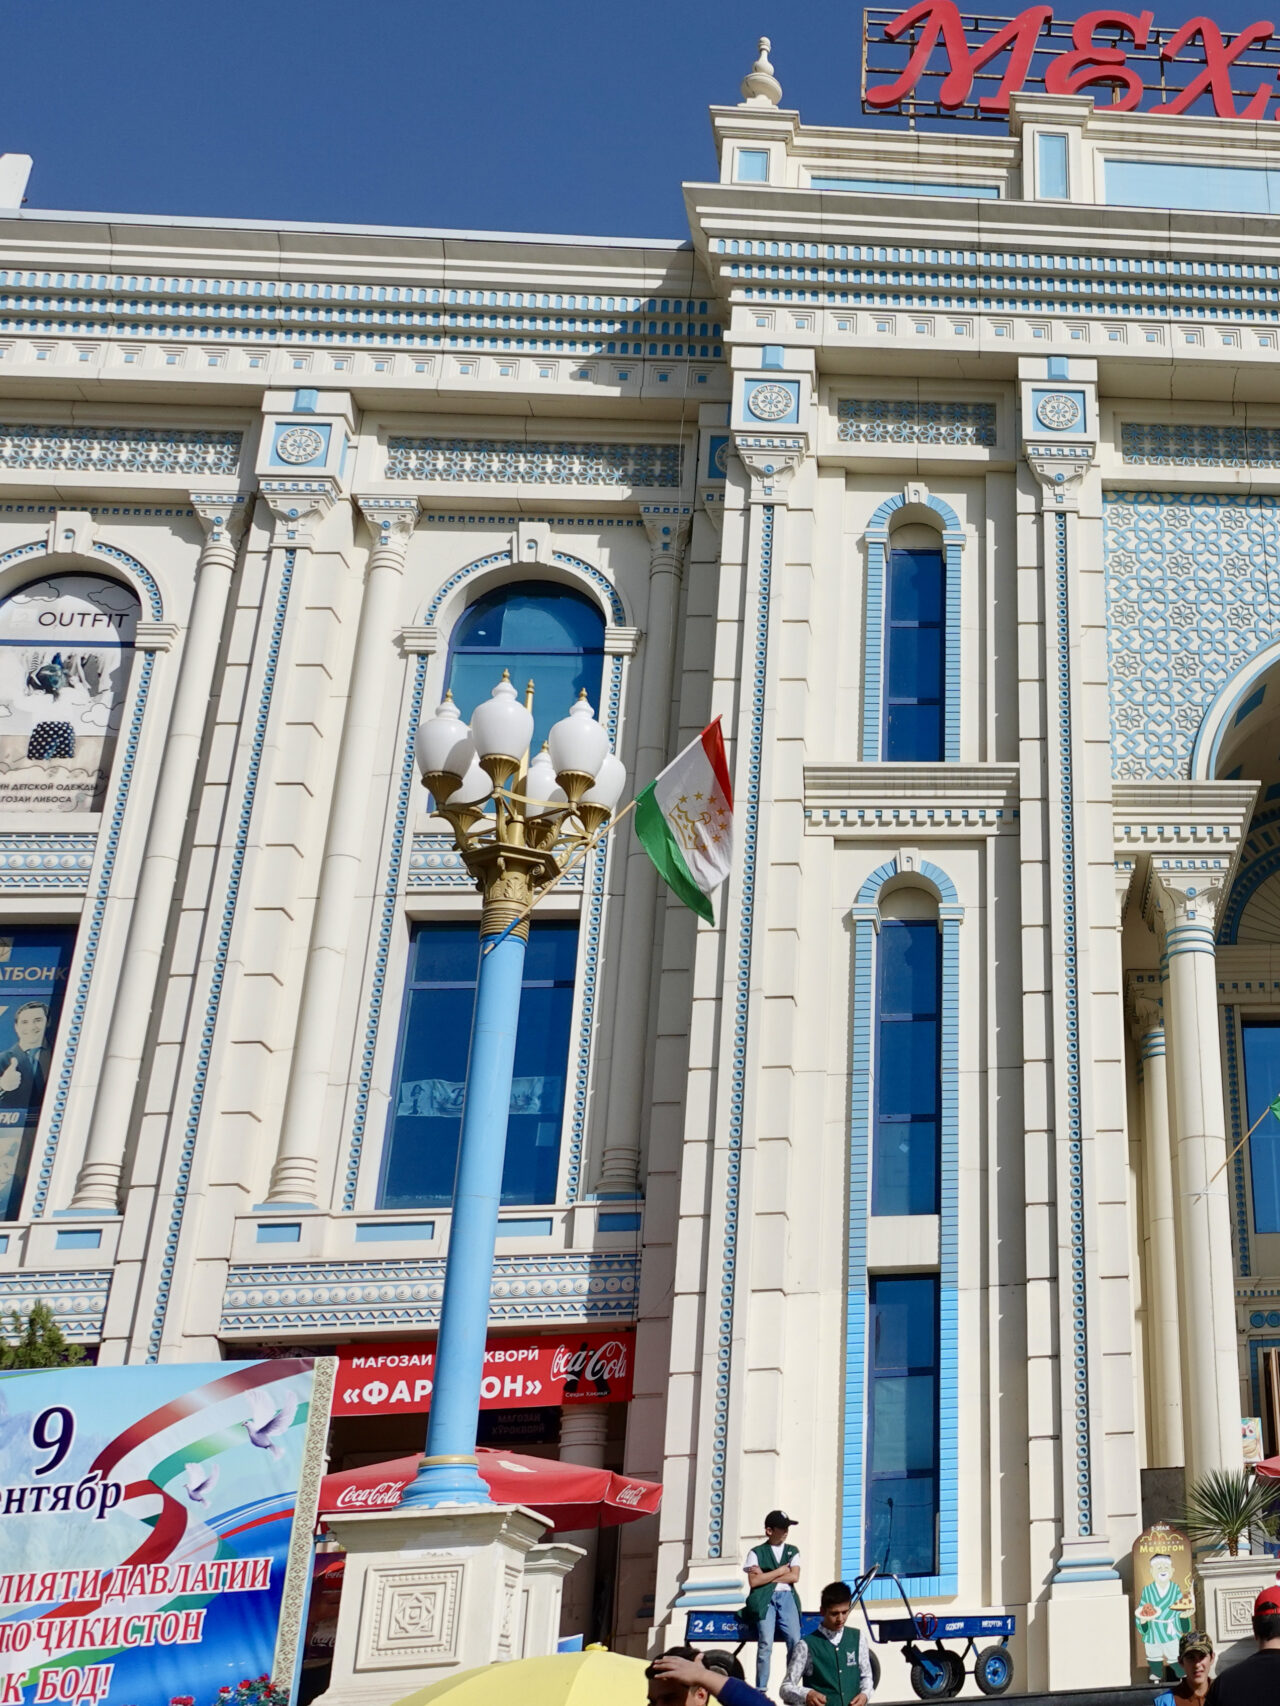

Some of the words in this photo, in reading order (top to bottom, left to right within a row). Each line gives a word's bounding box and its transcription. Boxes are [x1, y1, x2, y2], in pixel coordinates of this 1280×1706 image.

[38, 611, 130, 628] OUTFIT
[11, 782, 53, 791] ДЕТСКОЙ
[551, 1341, 627, 1382] Coca-Cola
[33, 1406, 74, 1476] 9
[0, 1472, 122, 1520] нтябр
[337, 1481, 402, 1508] Coca-Cola
[1140, 1544, 1184, 1555] Мехргон
[104, 1558, 271, 1604] ДАВЛАТИИ
[693, 1619, 715, 1633] 24
[38, 1666, 112, 1705] БОД!
